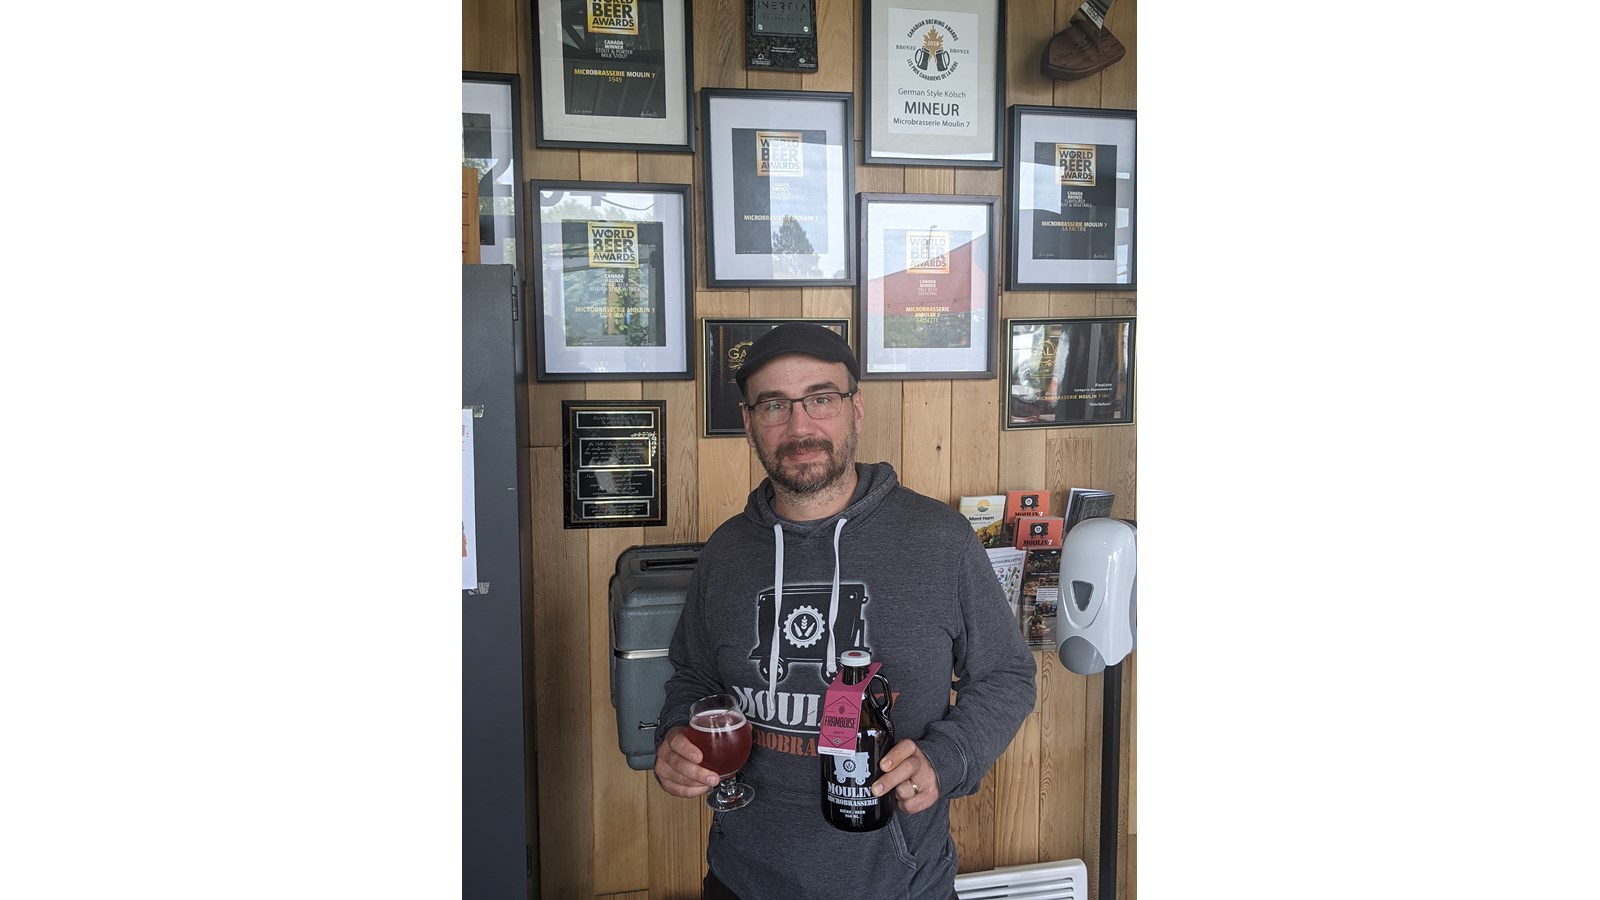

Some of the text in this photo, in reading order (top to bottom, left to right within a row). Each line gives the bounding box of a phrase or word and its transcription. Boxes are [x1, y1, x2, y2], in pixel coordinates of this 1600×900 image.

[592, 4, 634, 18] BEER
[592, 18, 634, 27] AWARDS
[907, 19, 958, 41] CANADIAN BREWING AWARDS
[574, 68, 625, 77] MICROBRASSERIE
[918, 72, 941, 81] CANADIENS
[927, 90, 942, 98] Style
[945, 90, 966, 98] Kölsch
[904, 101, 960, 116] MINEUR
[894, 118, 940, 126] Microbrasserie
[760, 139, 799, 148] WORLD
[761, 148, 798, 161] BEER
[1059, 151, 1093, 159] WORLD
[761, 162, 800, 170] AWARDS
[1060, 160, 1092, 172] BEER
[592, 229, 634, 239] WORLD
[593, 239, 634, 252] BEER
[910, 238, 946, 247] WORLD
[593, 253, 635, 262] AWARDS
[910, 247, 946, 259] BEER
[732, 685, 822, 726] MOUL
[824, 716, 857, 729] FRAMBOISE
[828, 781, 872, 798] MOULIN
[828, 795, 878, 806] MICROBRASSERIE
